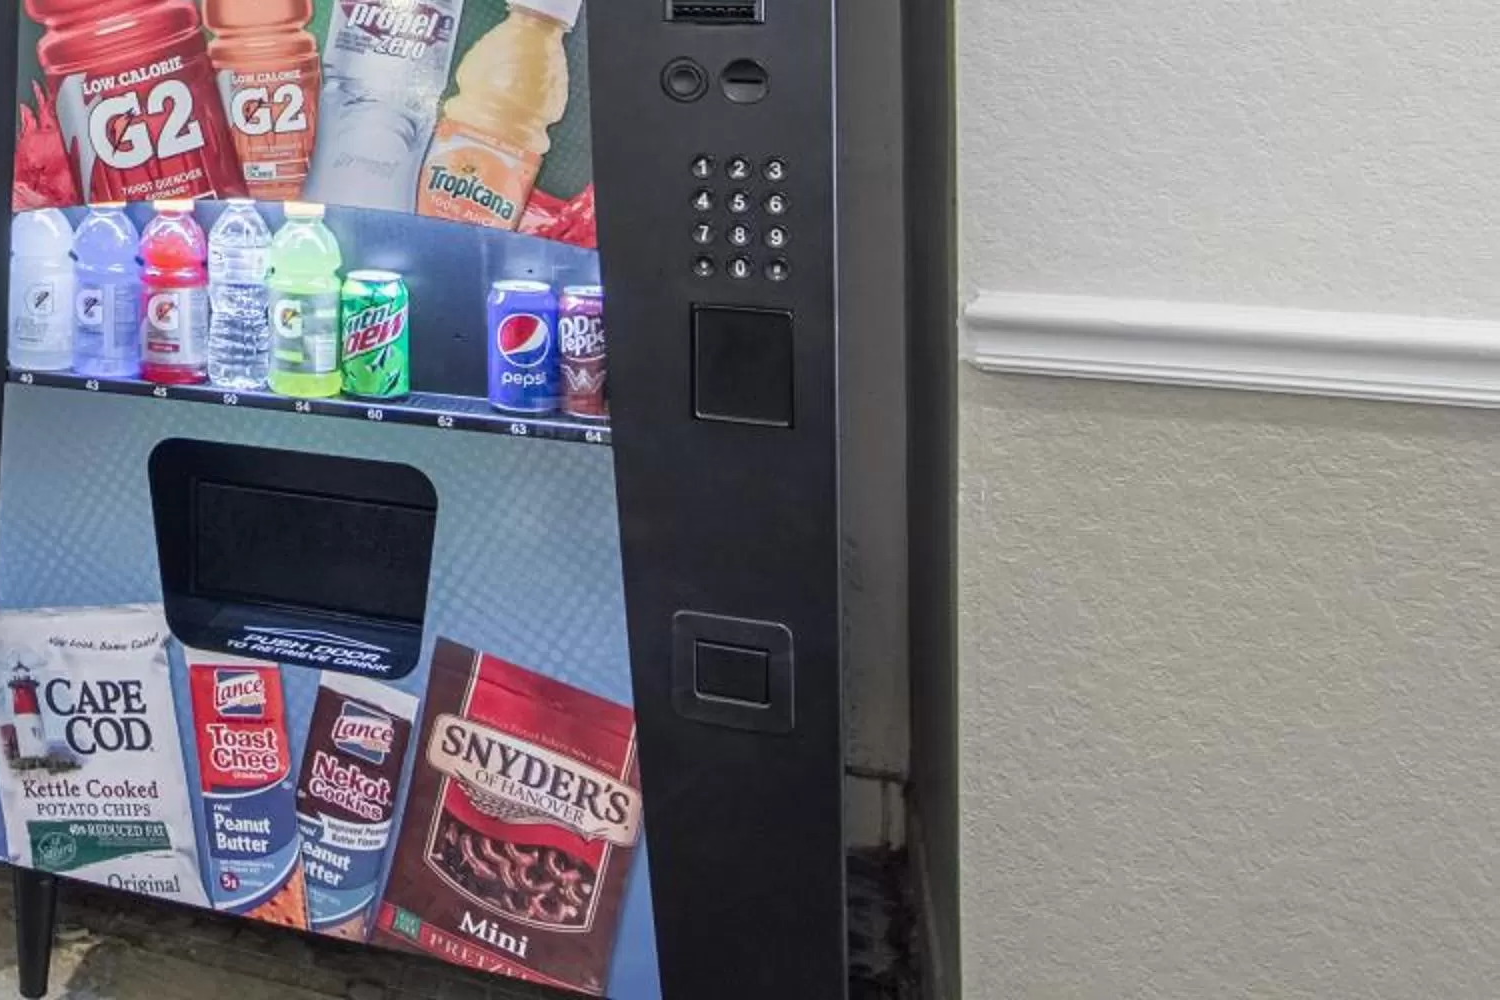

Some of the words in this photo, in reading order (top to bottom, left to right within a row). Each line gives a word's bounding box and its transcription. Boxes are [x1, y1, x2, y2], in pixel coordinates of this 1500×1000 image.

[347, 3, 439, 37] propel
[373, 35, 426, 61] zero
[82, 77, 116, 95] LOW
[118, 56, 185, 86] CALORIE
[231, 83, 307, 134] G2
[88, 79, 205, 169] G2
[697, 159, 707, 175] 1
[731, 160, 746, 179] 2
[769, 161, 782, 179] 3
[427, 165, 515, 220] Tropicana
[697, 192, 709, 209] 4
[734, 193, 746, 211] 5
[770, 195, 782, 213] 6
[699, 225, 709, 242] 7
[735, 227, 746, 243] 8
[771, 229, 783, 245] 9
[735, 259, 746, 277] 0
[501, 371, 547, 388] pepsi
[367, 409, 383, 421] 60
[437, 416, 454, 427] 62
[510, 424, 527, 434] 63
[585, 431, 602, 442] 64
[227, 639, 247, 649] TO
[250, 643, 329, 662] RETRIEVE
[332, 657, 393, 673] DRINK
[243, 633, 309, 649] PUSH
[313, 644, 381, 662] DOOR
[45, 678, 147, 716] CAPE
[215, 678, 263, 707] Lance
[65, 715, 153, 754] COD
[207, 724, 276, 751] Toast
[333, 716, 394, 742] Lance
[212, 747, 279, 772] Chee
[313, 751, 391, 805] Nekot
[441, 725, 630, 825] SNYDER'S
[23, 779, 81, 799] Kettle
[85, 779, 159, 799] Cooked
[309, 778, 383, 821] Cookies
[475, 769, 495, 787] OF
[501, 778, 585, 824] HANOVER
[37, 803, 99, 817] POTATO
[102, 803, 152, 817] CHIPS
[87, 823, 143, 838] REDUCED
[145, 823, 166, 838] FAT
[213, 812, 271, 835] Peanut
[216, 832, 270, 853] Butter
[301, 837, 351, 871] eanut
[108, 873, 182, 894] Original
[303, 860, 344, 887] tter
[458, 910, 530, 959] Mini
